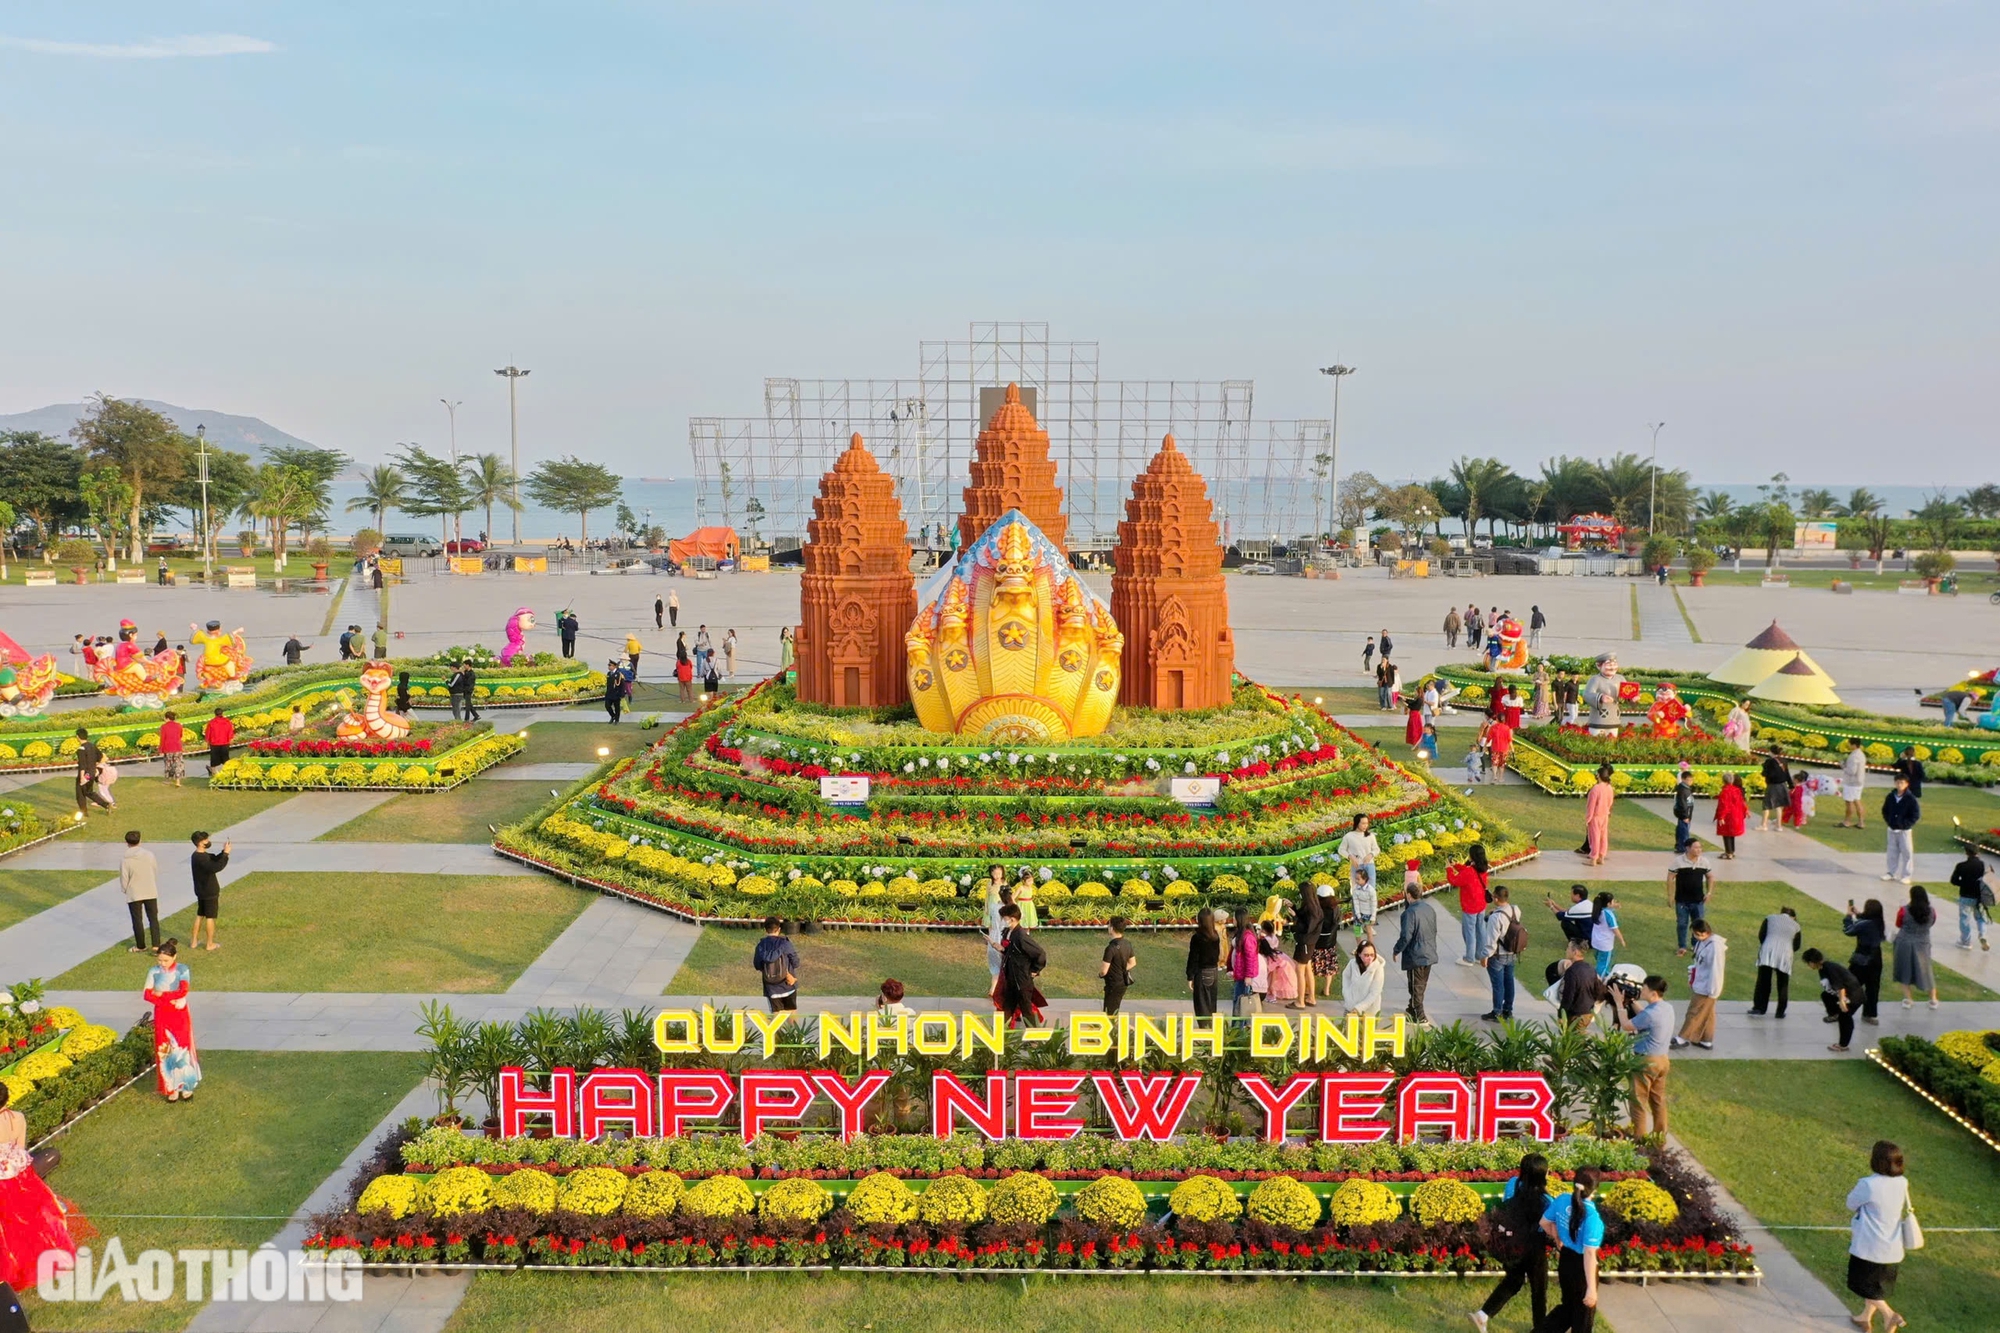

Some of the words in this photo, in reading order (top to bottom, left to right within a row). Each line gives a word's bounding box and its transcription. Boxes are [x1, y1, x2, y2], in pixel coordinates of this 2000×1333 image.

[654, 1004, 792, 1060] QUY
[819, 1011, 1004, 1061] NHON
[1069, 1011, 1223, 1063] BINH
[1250, 1012, 1406, 1064] DINH
[499, 1066, 892, 1147] HAPPY
[932, 1069, 1204, 1142] NEW
[1234, 1071, 1556, 1145] YEAR
